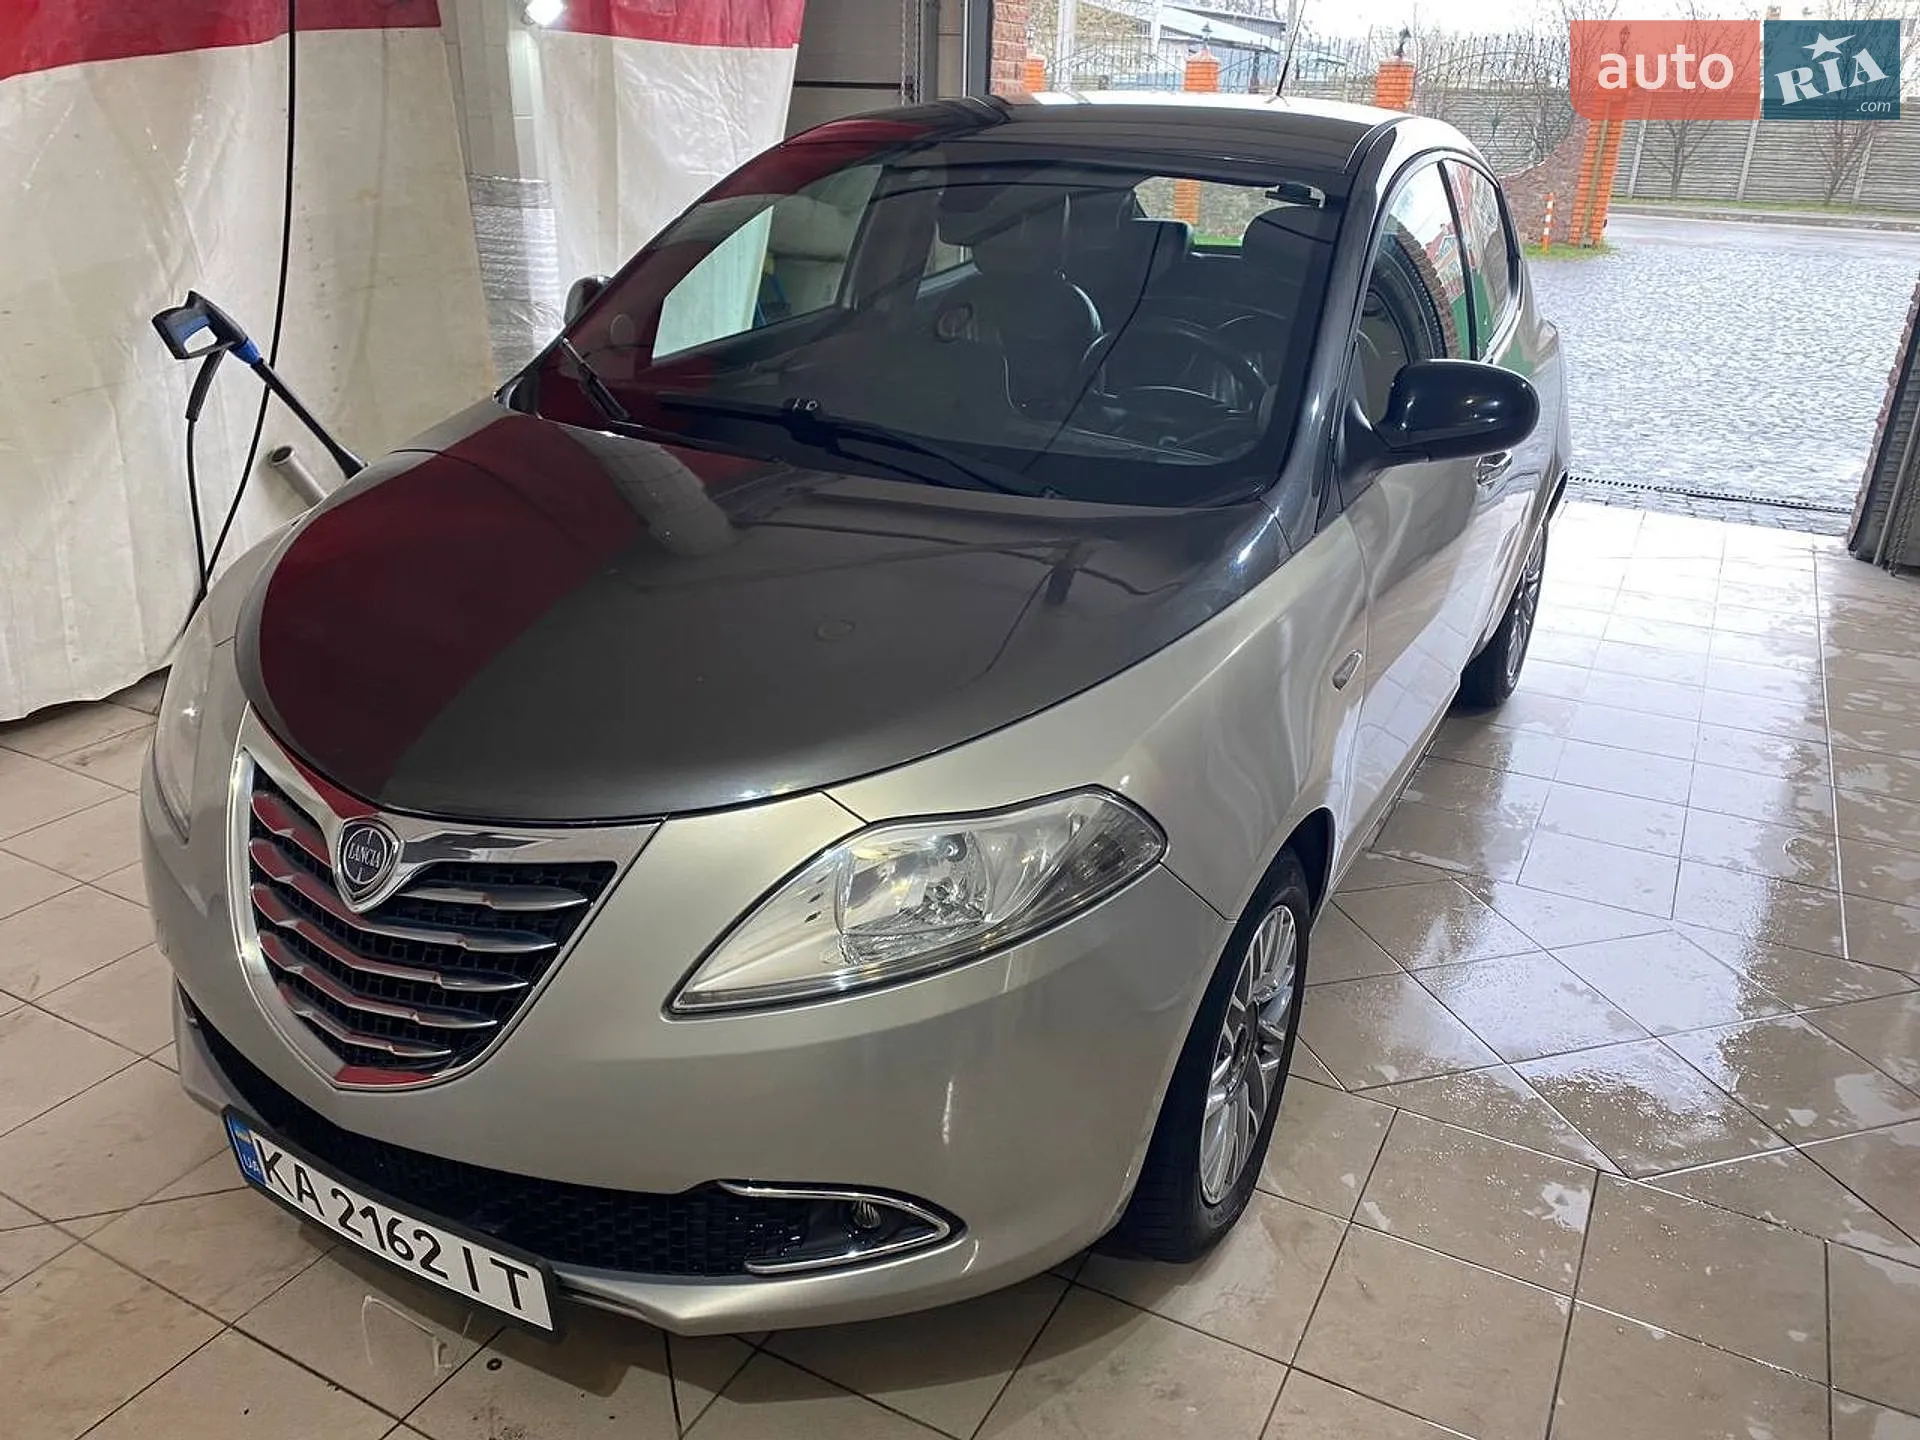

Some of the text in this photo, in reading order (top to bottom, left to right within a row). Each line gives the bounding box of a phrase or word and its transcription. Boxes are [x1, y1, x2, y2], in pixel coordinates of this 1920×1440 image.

[348, 842, 381, 869] LANCIA
[254, 1138, 529, 1311] KA 2162 IT
